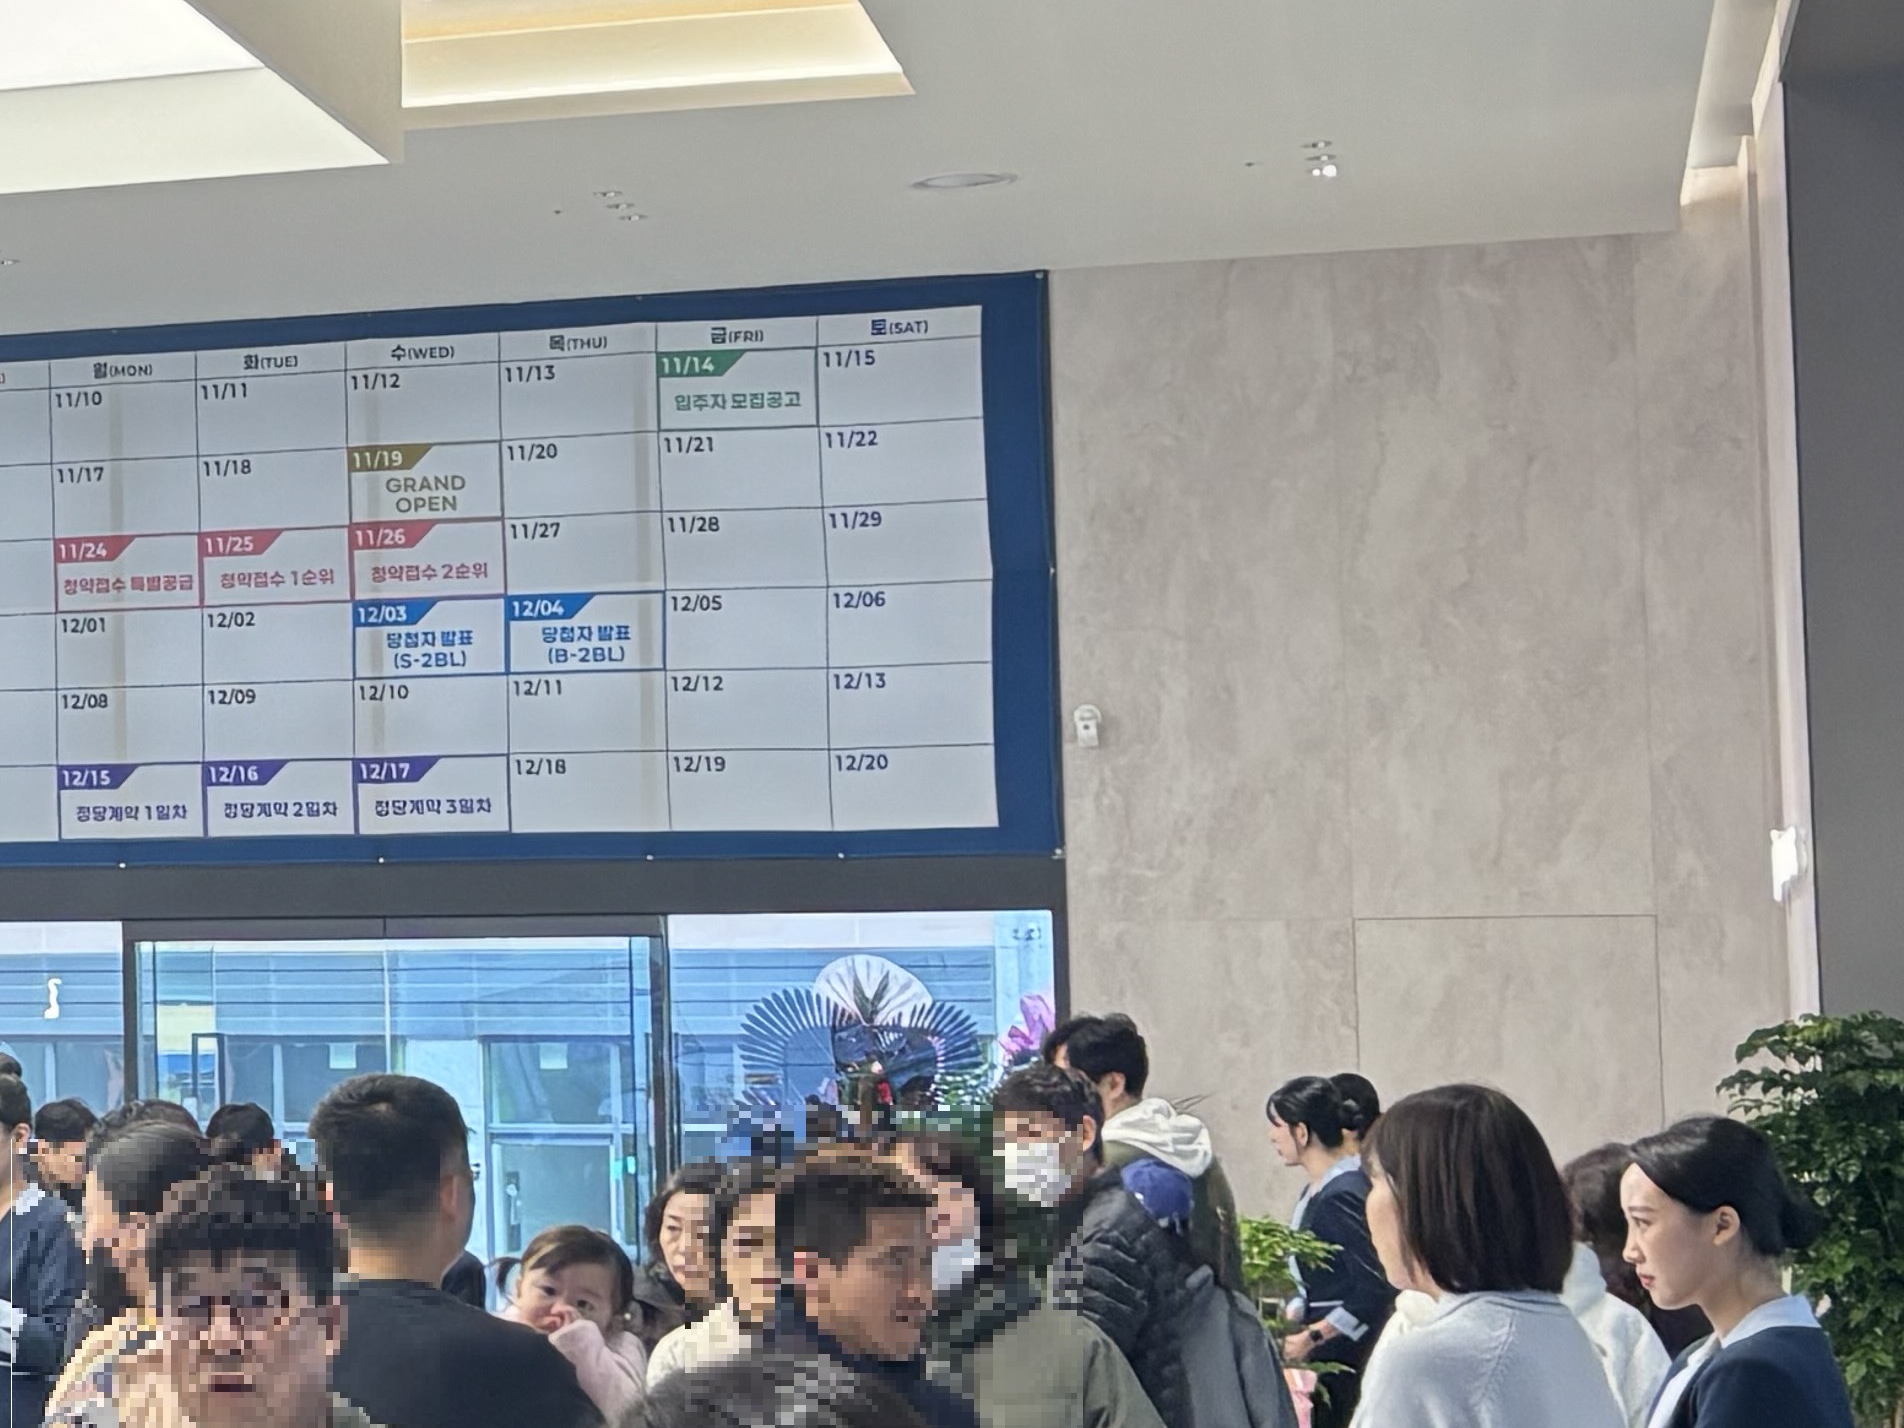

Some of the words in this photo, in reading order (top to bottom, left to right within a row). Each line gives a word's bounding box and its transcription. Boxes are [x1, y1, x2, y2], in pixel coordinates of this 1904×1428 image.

[661, 356, 715, 375] 11/14
[823, 348, 876, 368] 11/15
[351, 373, 400, 391] 11/12
[505, 364, 555, 383] 11/13
[55, 390, 102, 408] 11/10
[200, 382, 248, 401] 11/11
[674, 392, 728, 411] 입주자
[731, 391, 801, 410] 모집공고
[664, 436, 714, 455] 11/21
[825, 430, 878, 449] 11/22
[353, 450, 402, 470] 11/19
[507, 443, 558, 463] 11/20
[57, 465, 104, 484] 11/17
[203, 458, 252, 478] 11/18
[386, 474, 466, 495] GRAND
[395, 495, 457, 514] OPEN
[667, 515, 720, 534] 11/28
[829, 510, 882, 529] 11/29
[355, 528, 406, 548] 11/26
[510, 522, 560, 541] 11/27
[59, 541, 107, 560] 11/24
[205, 536, 253, 555] 11/25
[290, 568, 335, 587] 1순위
[443, 561, 488, 581] 2순위
[512, 599, 564, 617] 12/04
[671, 594, 722, 613] 12/05
[833, 590, 886, 609] 12/06
[207, 611, 255, 629] 12/02
[357, 605, 407, 624] 12/03
[61, 617, 106, 635] 12/01
[541, 626, 594, 644] 당첨자
[597, 624, 631, 643] 발표
[387, 630, 437, 649] 당첨자
[441, 630, 473, 647] 발표
[393, 649, 466, 670] (S-2BL)
[547, 646, 626, 666] (B-2BL)
[513, 678, 563, 697] 12/11
[672, 675, 724, 693] 12/12
[833, 672, 886, 691] 12/13
[61, 692, 108, 711] 12/08
[208, 688, 256, 706] 12/09
[359, 683, 409, 702] 12/10
[360, 761, 410, 781] 12/17
[515, 757, 566, 776] 12/18
[673, 755, 726, 774] 12/19
[835, 752, 889, 772] 12/20
[62, 766, 111, 787] 12/15
[208, 764, 259, 783] 12/16
